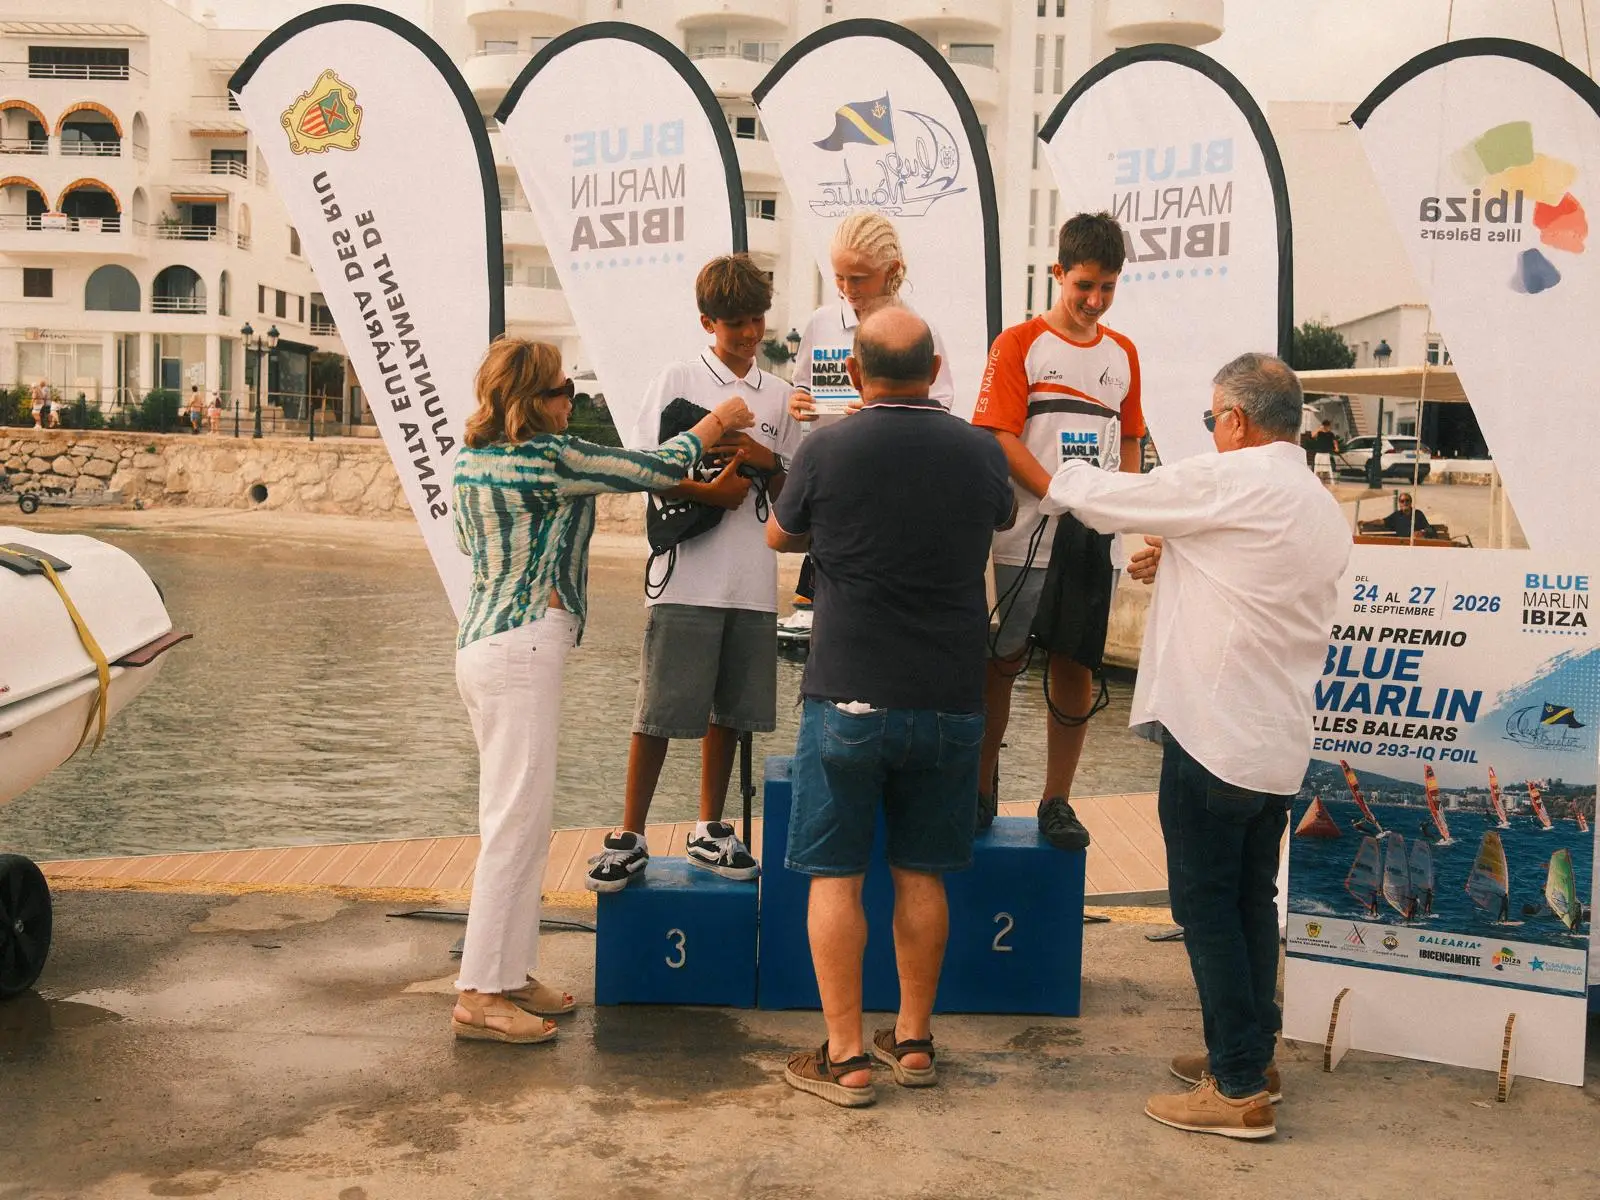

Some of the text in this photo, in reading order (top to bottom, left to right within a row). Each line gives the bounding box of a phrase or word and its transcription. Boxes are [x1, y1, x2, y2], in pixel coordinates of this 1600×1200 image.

[812, 362, 848, 374] MARLI
[1061, 432, 1098, 444] BLUE
[1062, 445, 1099, 456] MARLIN
[1525, 573, 1589, 591] BLUE
[1352, 584, 1501, 612] 24 AL 27 2026
[1523, 591, 1589, 610] MARLIN
[1353, 604, 1435, 617] DE SEPTIEMBRE
[1522, 609, 1588, 628] IBIZA
[1330, 624, 1467, 647] RAN PREMIO
[1313, 680, 1483, 723] MARLIN
[1362, 720, 1459, 742] BALEARS
[1313, 737, 1479, 764] ECHNO 293-IQ FOIL
[992, 912, 1013, 951] 2
[665, 928, 686, 968] 3
